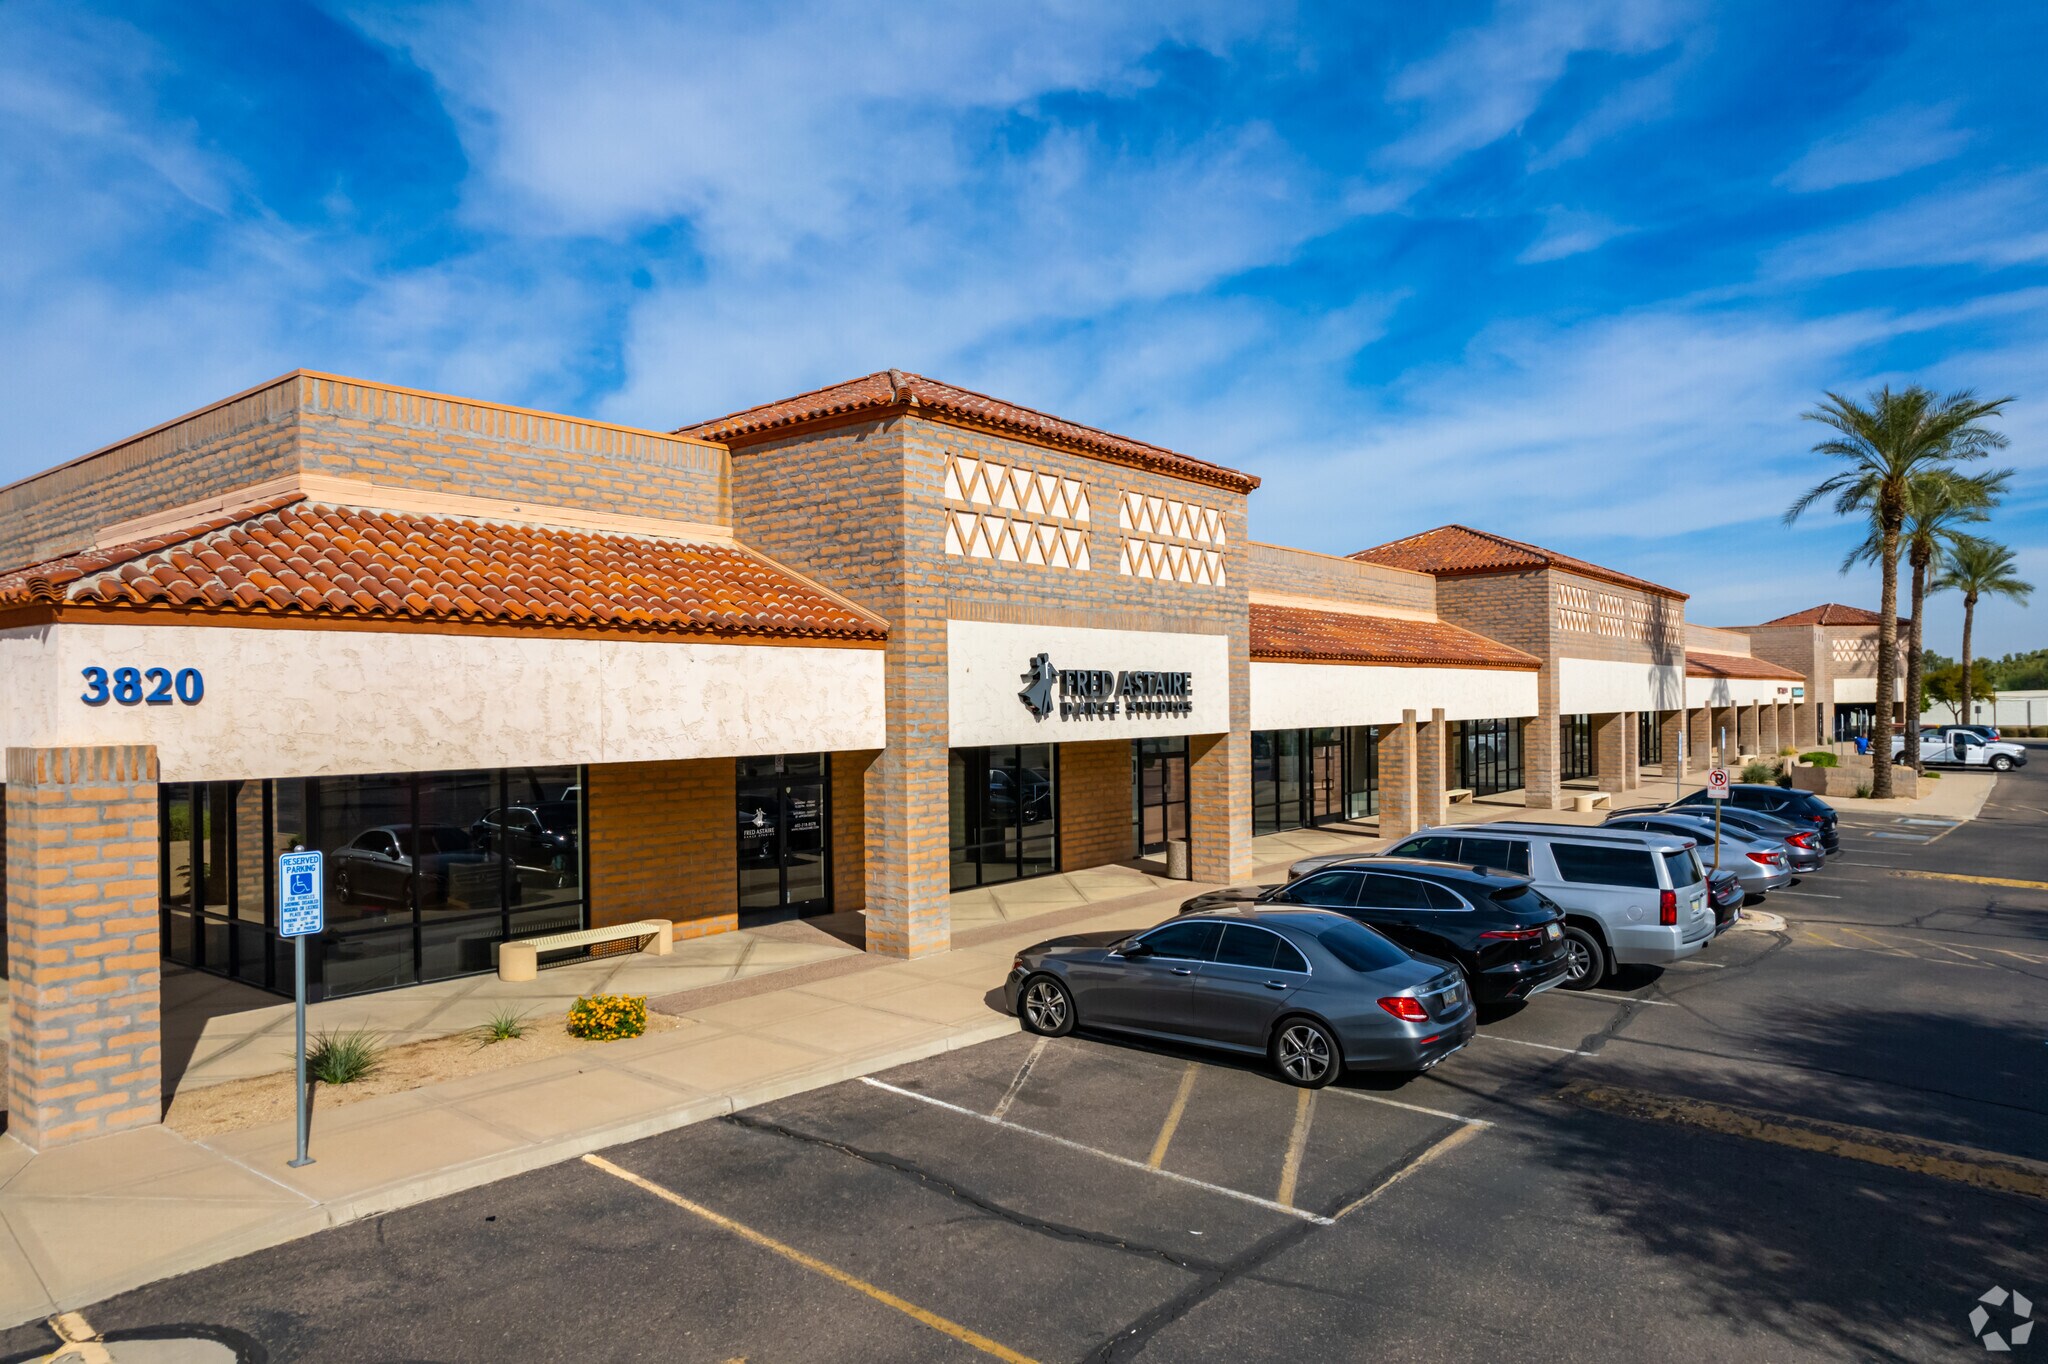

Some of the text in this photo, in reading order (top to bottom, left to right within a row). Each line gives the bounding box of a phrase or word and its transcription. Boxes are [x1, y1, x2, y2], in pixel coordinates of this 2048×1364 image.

[81, 666, 204, 706] 3820
[1060, 670, 1192, 697] FRED ASTAIRE
[1060, 701, 1192, 715] DANCE STUDIOS
[284, 856, 318, 865] RESERVED
[287, 864, 315, 873] PARKING
